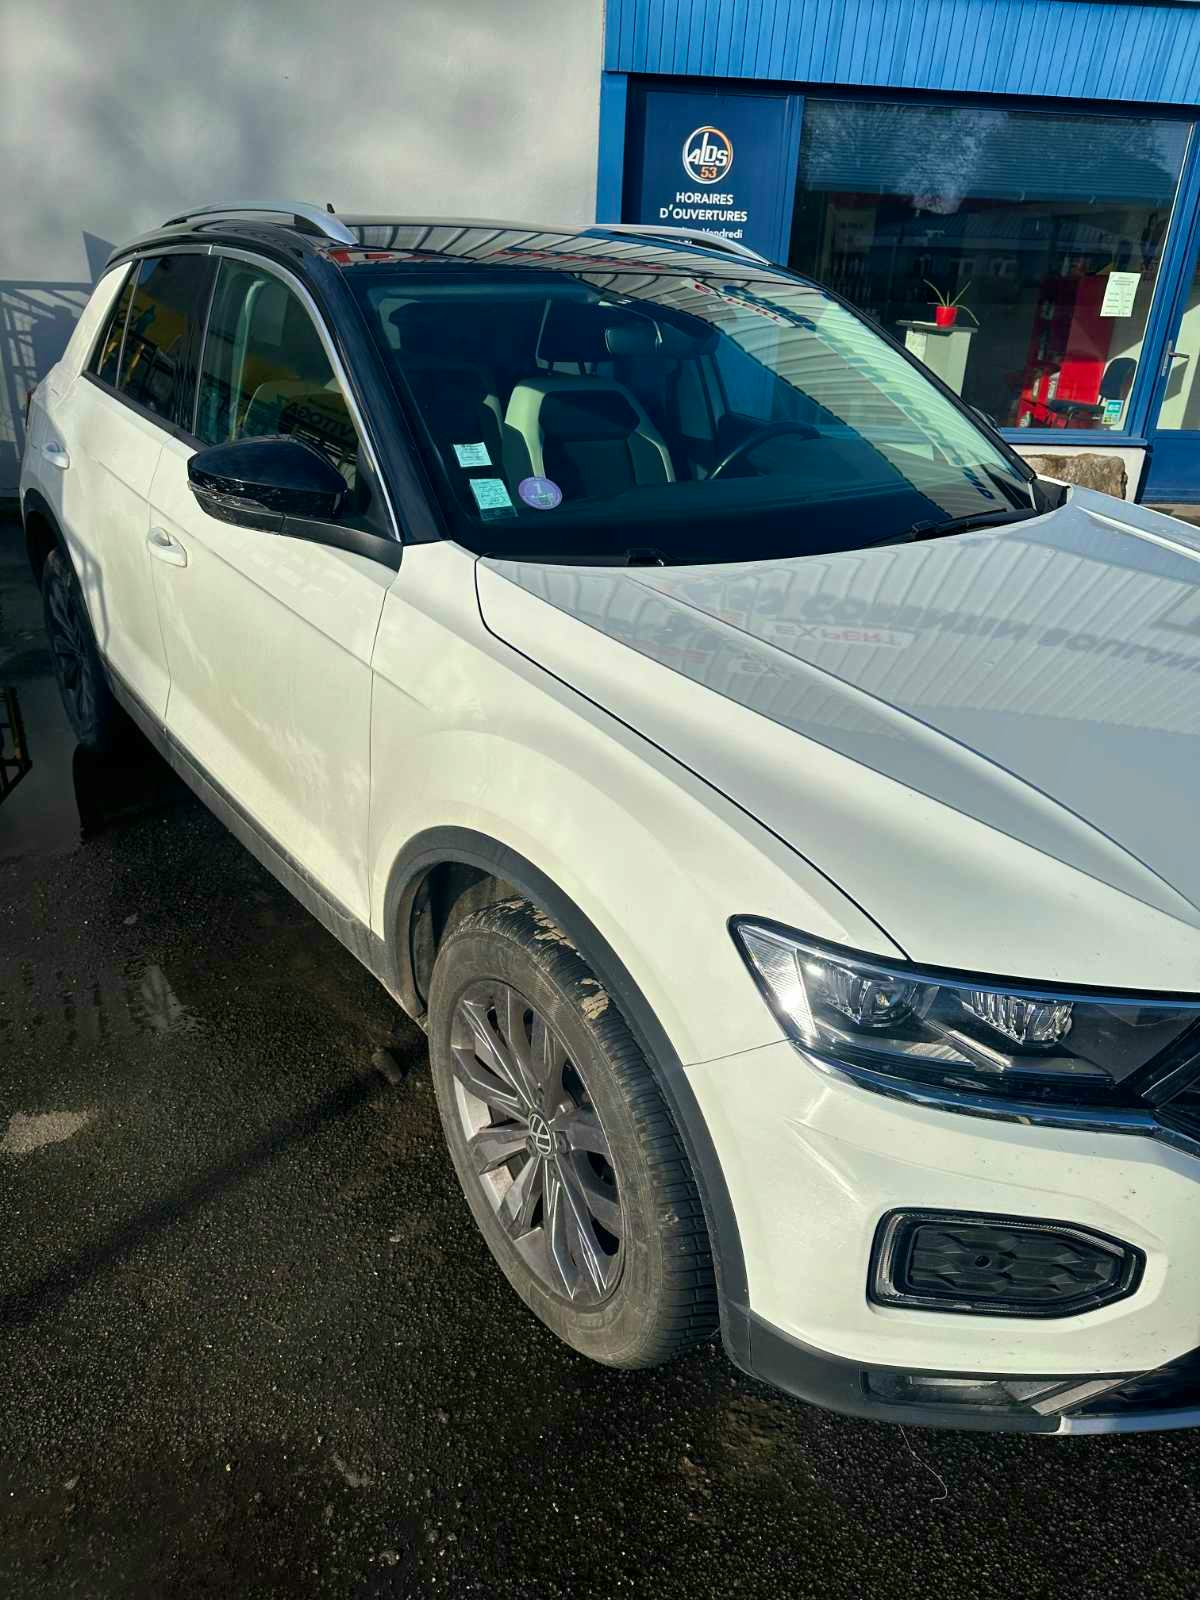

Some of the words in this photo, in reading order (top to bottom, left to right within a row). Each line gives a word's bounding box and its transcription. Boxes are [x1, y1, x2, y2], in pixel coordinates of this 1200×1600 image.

[700, 167, 717, 178] 53
[676, 192, 734, 205] HORAIRES
[660, 204, 748, 222] D'OUVERTURES
